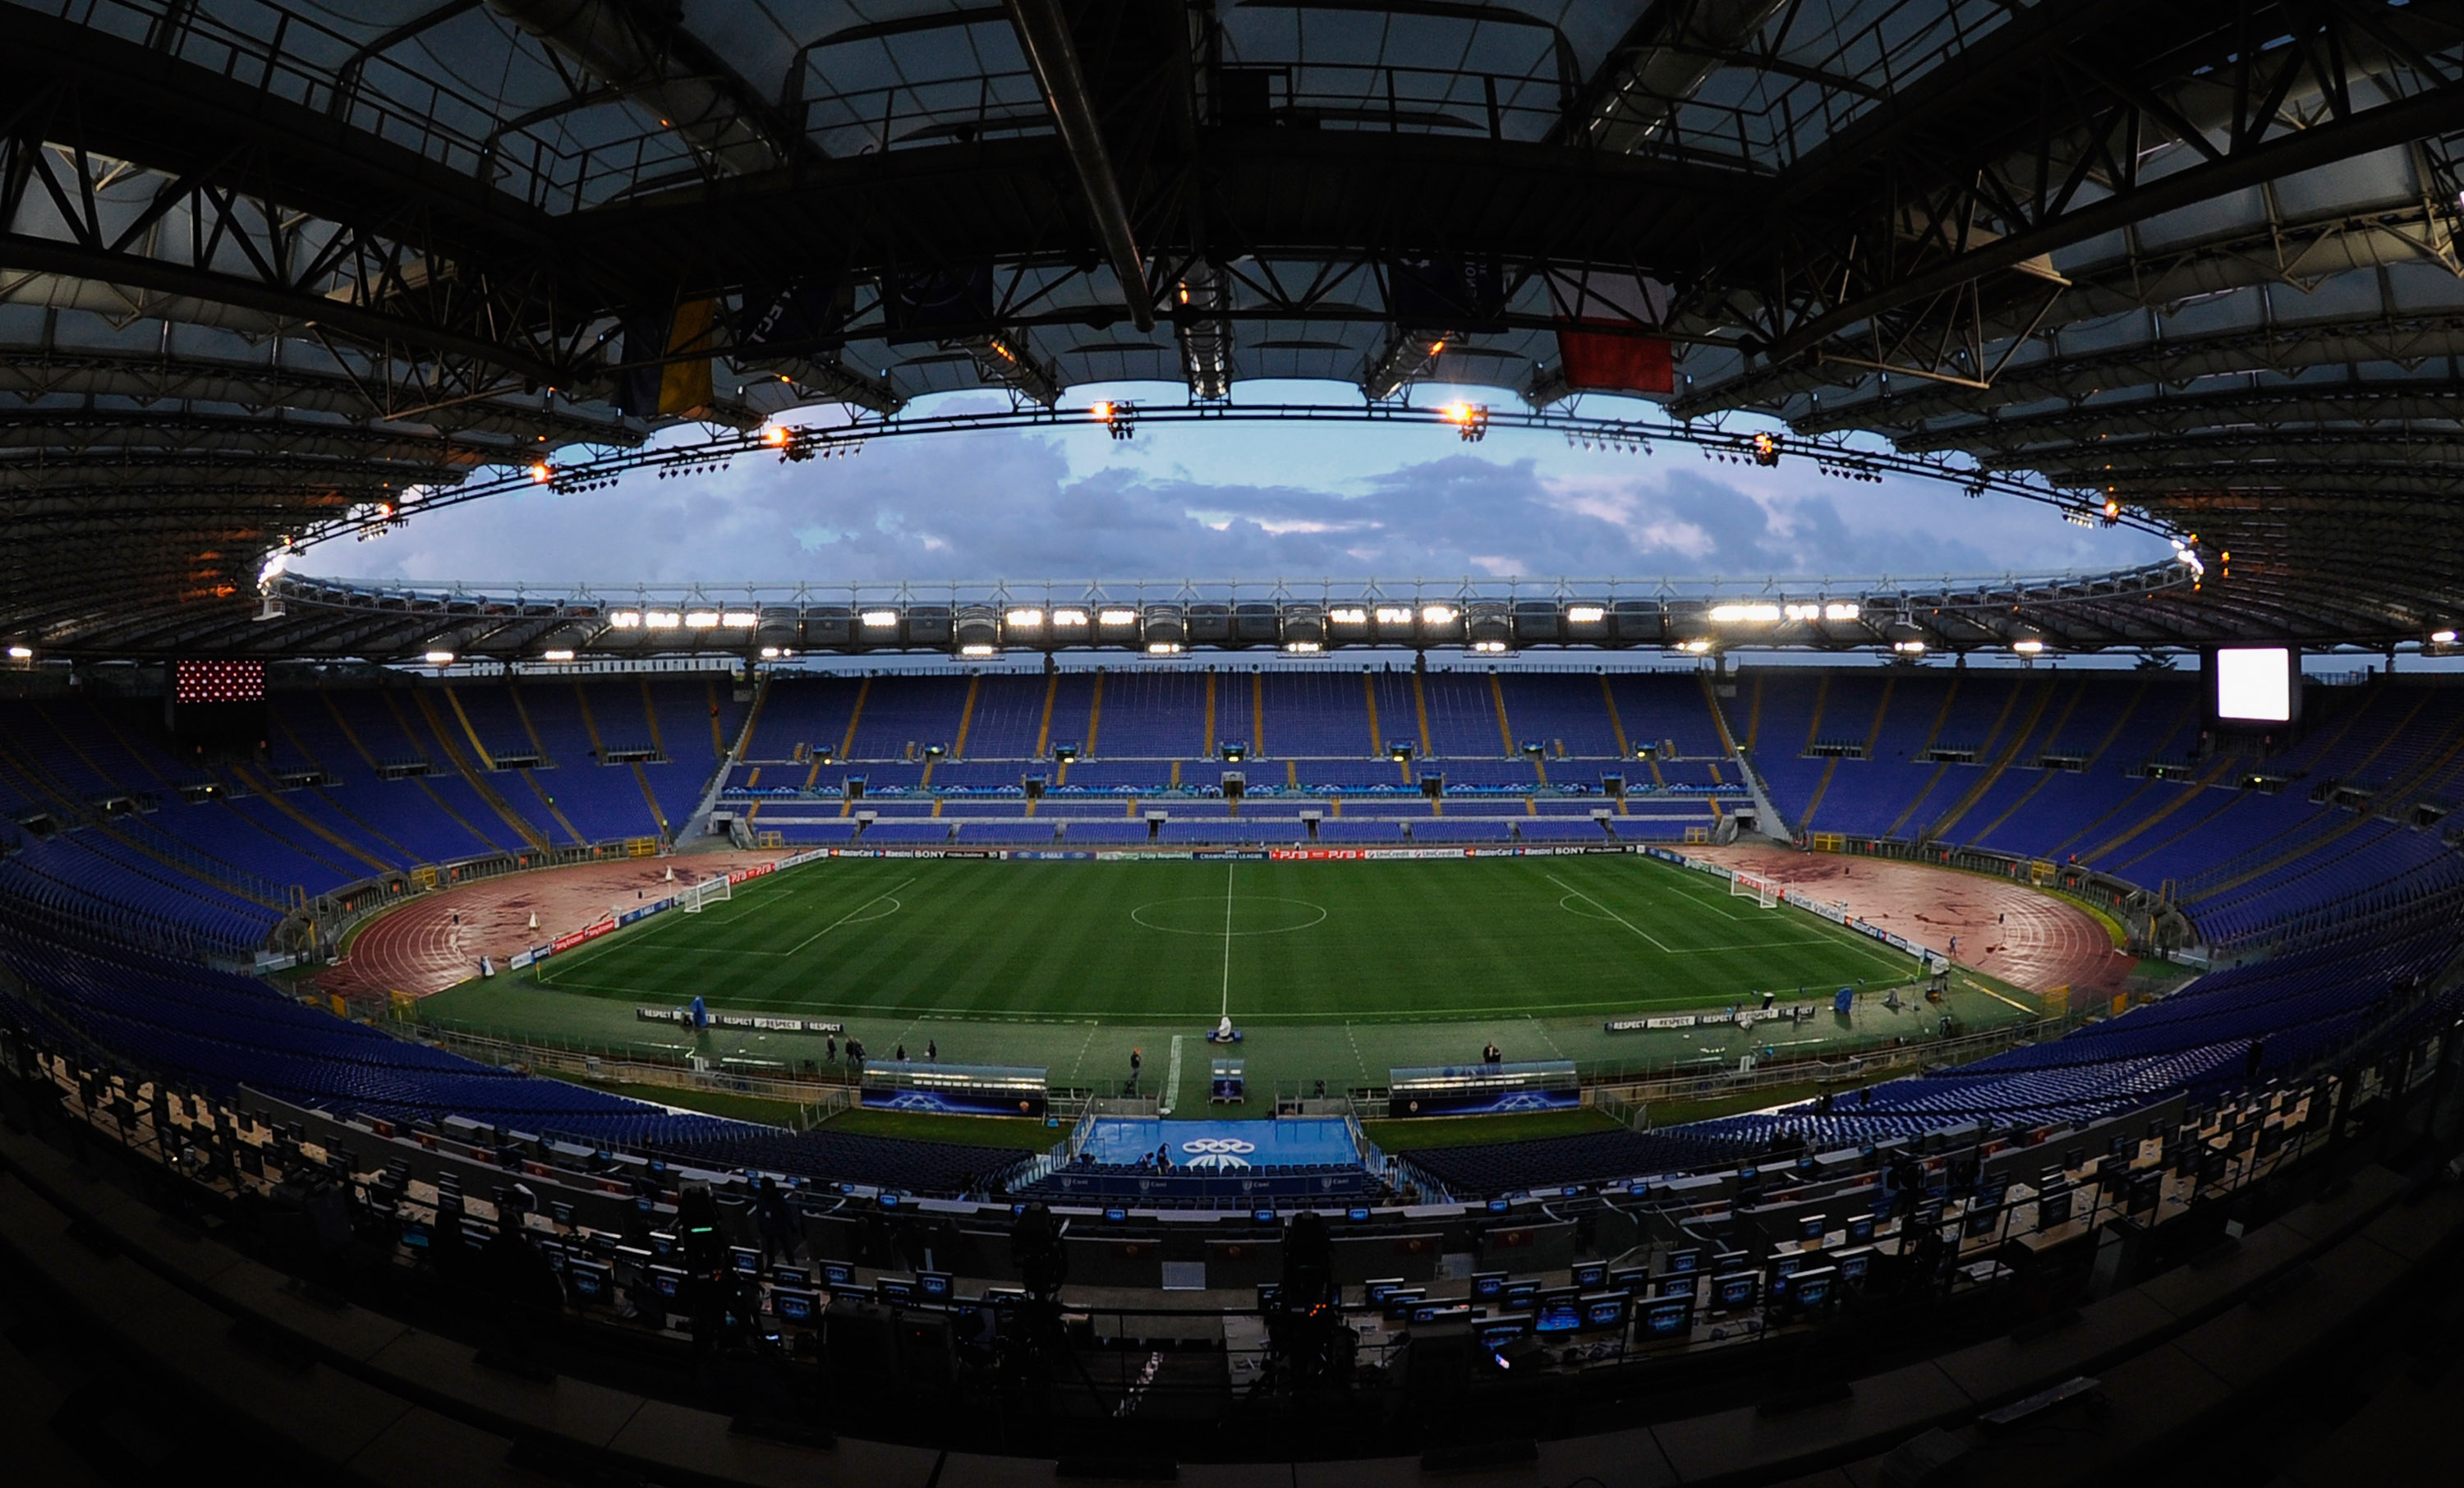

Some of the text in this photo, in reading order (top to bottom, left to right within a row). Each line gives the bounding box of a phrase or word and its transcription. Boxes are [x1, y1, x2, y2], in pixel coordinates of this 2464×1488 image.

[1280, 851, 1308, 859] PS3
[1328, 850, 1356, 859] PS3
[1376, 850, 1409, 858] UniCredit
[1423, 849, 1455, 857] UniCredit
[1555, 847, 1585, 855] SONY
[645, 1009, 671, 1018] RESPECT
[723, 1016, 752, 1026] RESPECT
[1659, 1017, 1689, 1026] RESPECT
[1703, 1014, 1733, 1023] RESPECT
[810, 1022, 840, 1031] RESPECT
[1613, 1020, 1646, 1030] RESPECT
